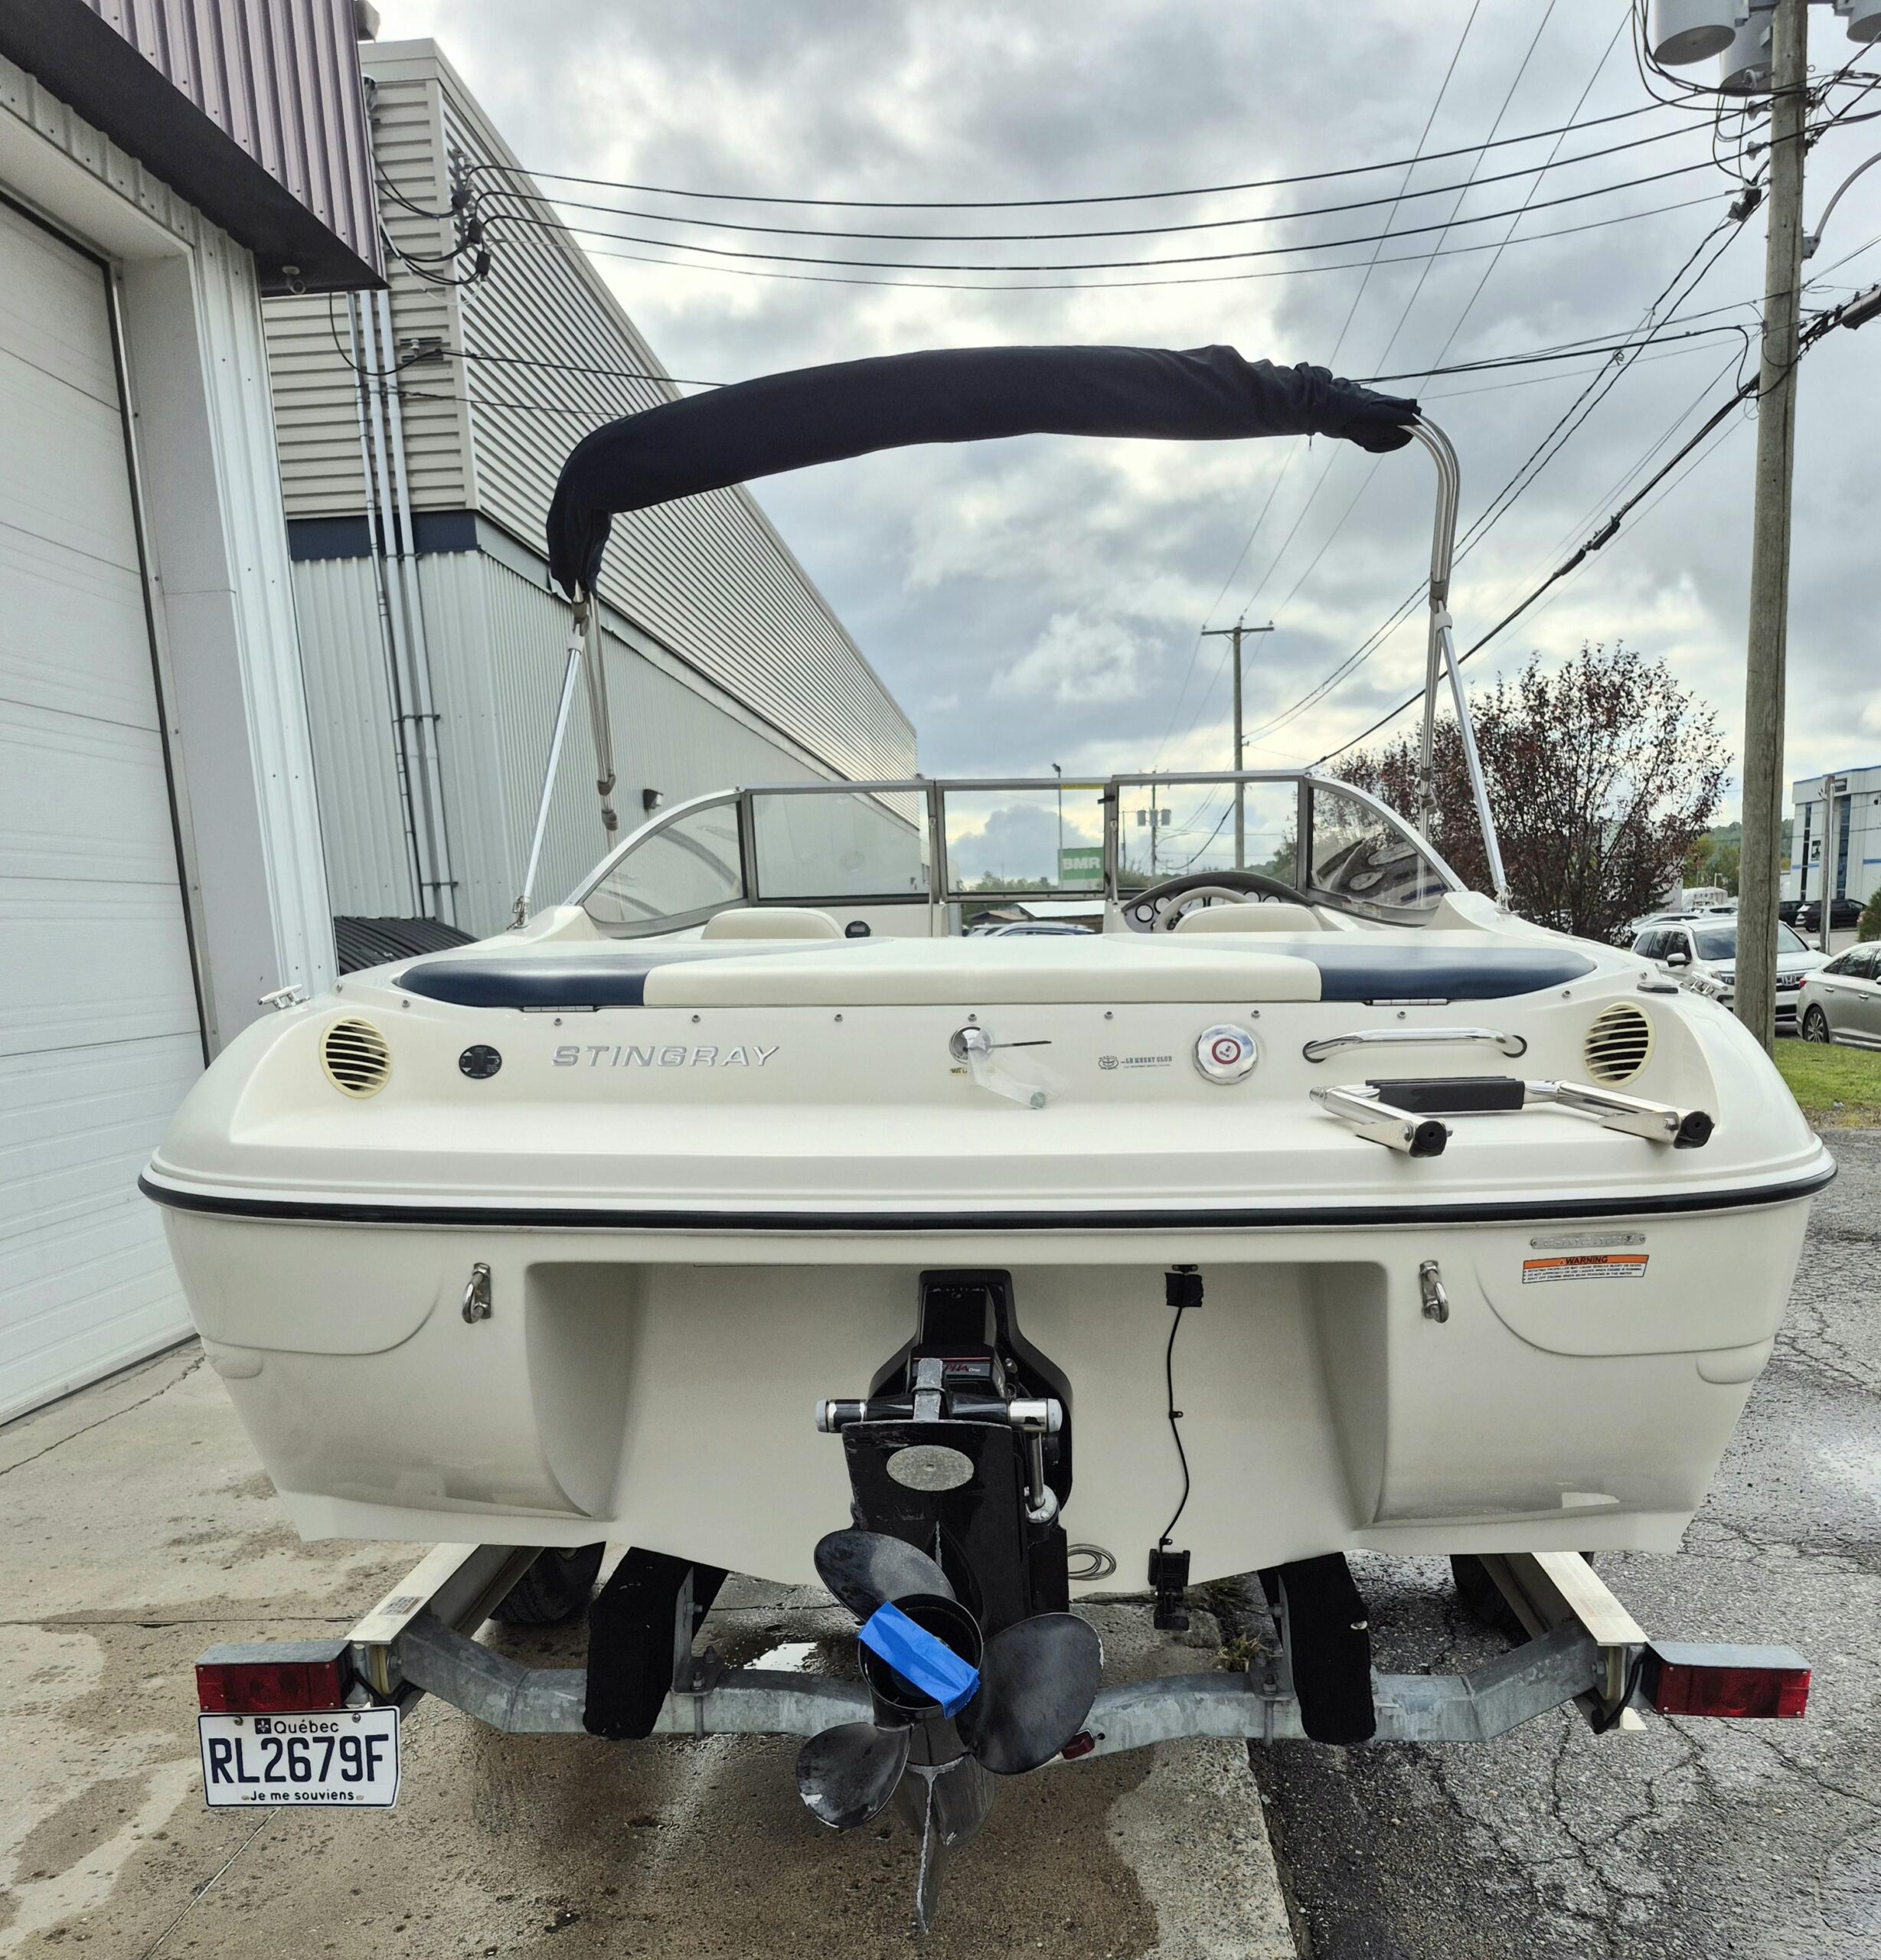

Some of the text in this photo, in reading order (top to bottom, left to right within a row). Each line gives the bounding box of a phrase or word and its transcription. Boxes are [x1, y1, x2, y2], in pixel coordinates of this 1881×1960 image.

[1063, 857, 1101, 870] BMR
[550, 1045, 780, 1067] STINGRAY
[1566, 1256, 1608, 1265] WARNING
[944, 1364, 968, 1372] PHA
[274, 1719, 339, 1733] Québec
[208, 1733, 389, 1783] RL2679F
[250, 1791, 266, 1801] Je
[294, 1789, 354, 1801] souviens
